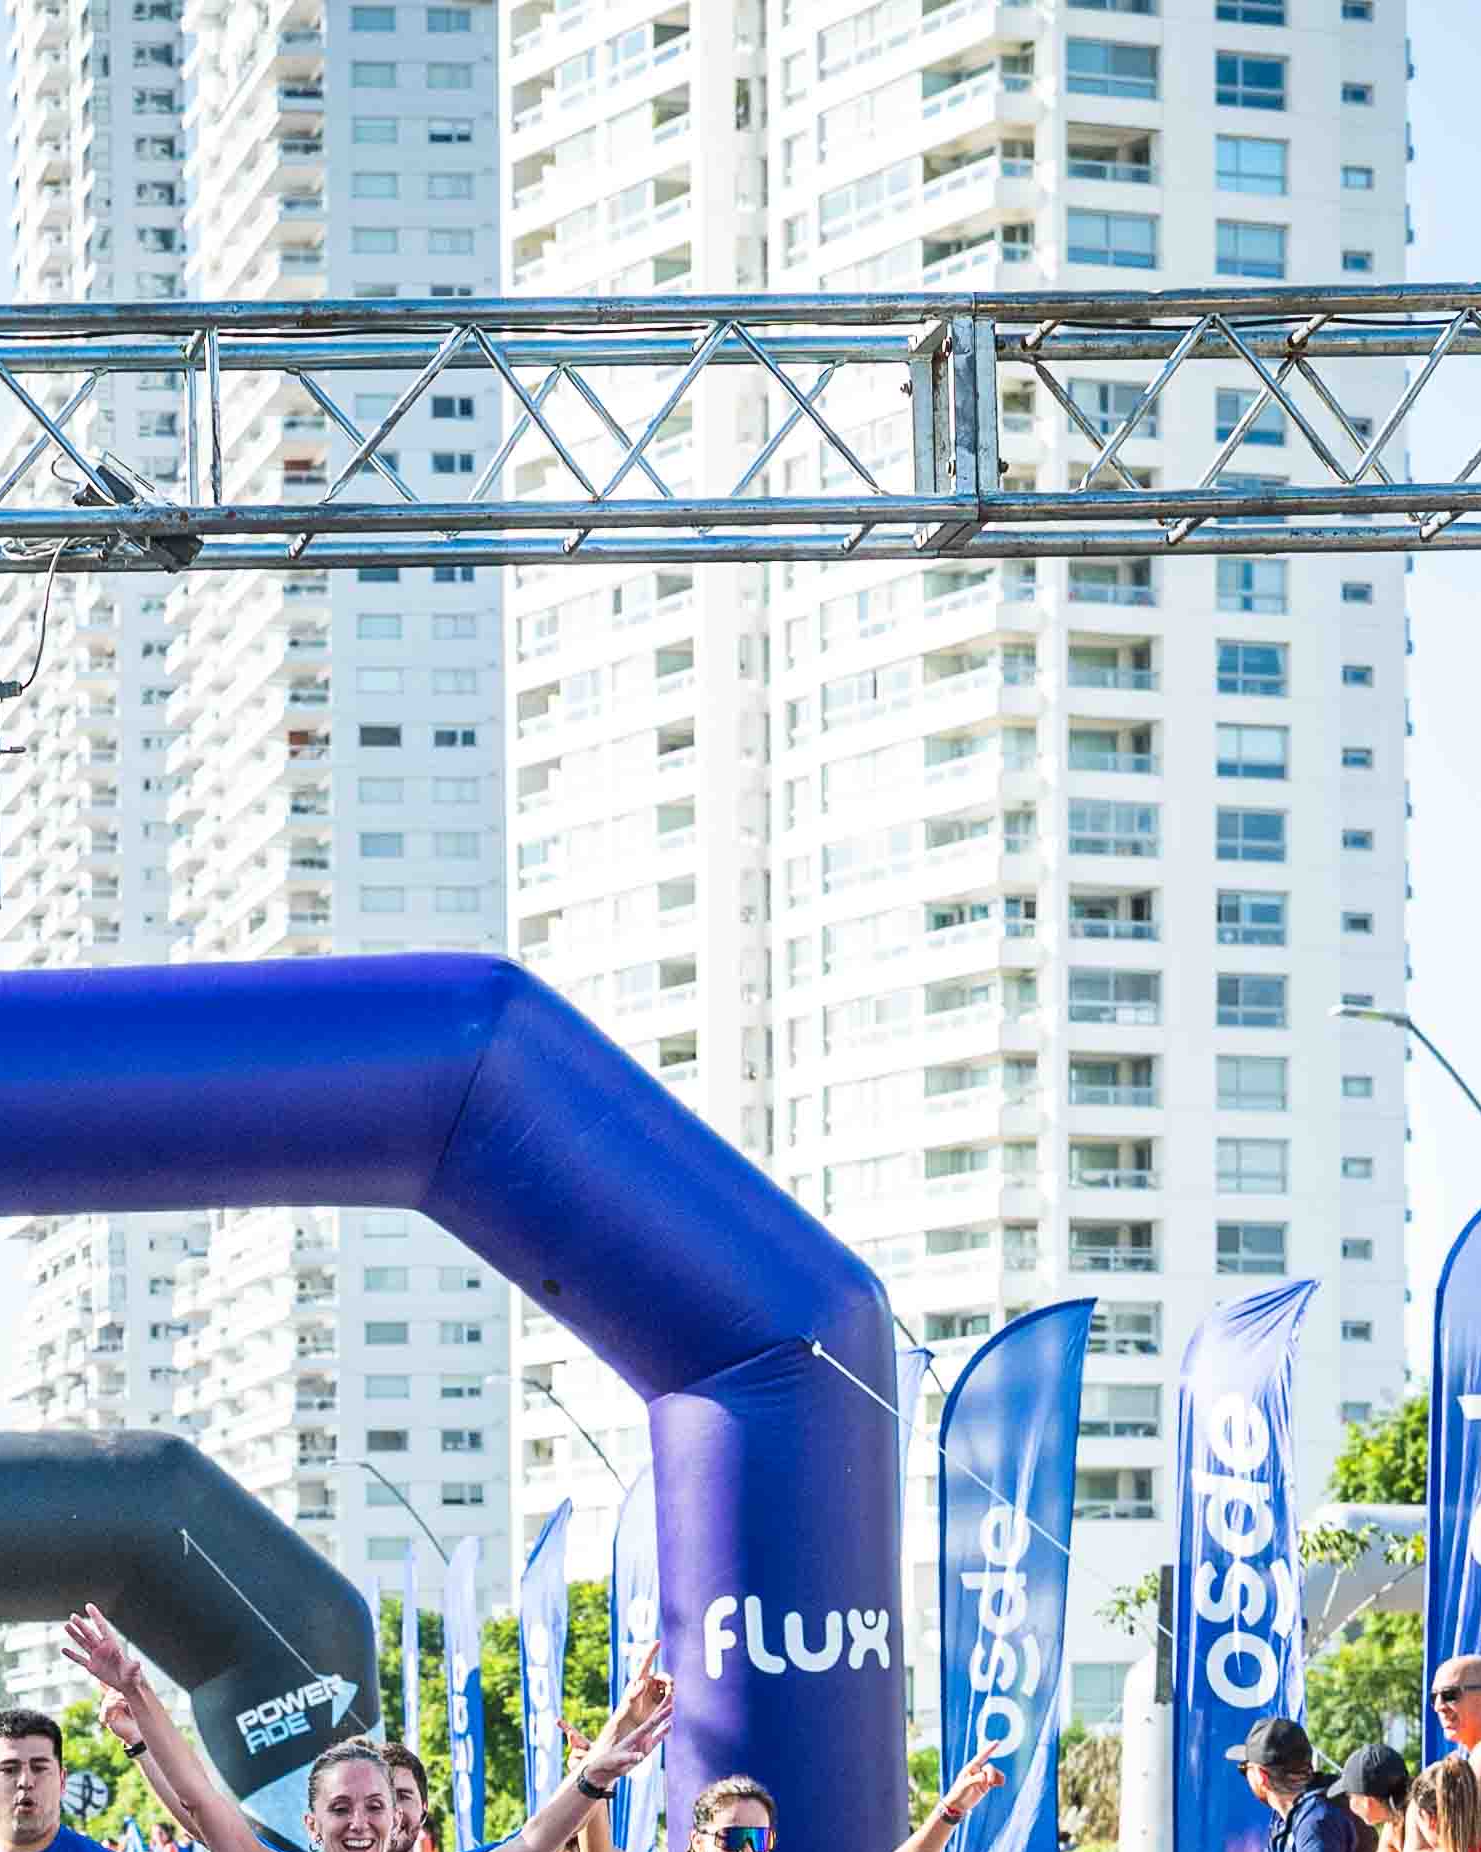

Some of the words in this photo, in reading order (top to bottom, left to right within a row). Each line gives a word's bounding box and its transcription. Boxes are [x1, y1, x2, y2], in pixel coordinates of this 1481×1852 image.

[1192, 1392, 1295, 1709] osde
[236, 1673, 343, 1736] POWER
[960, 1504, 1039, 1758] osde
[245, 1711, 312, 1755] ADE
